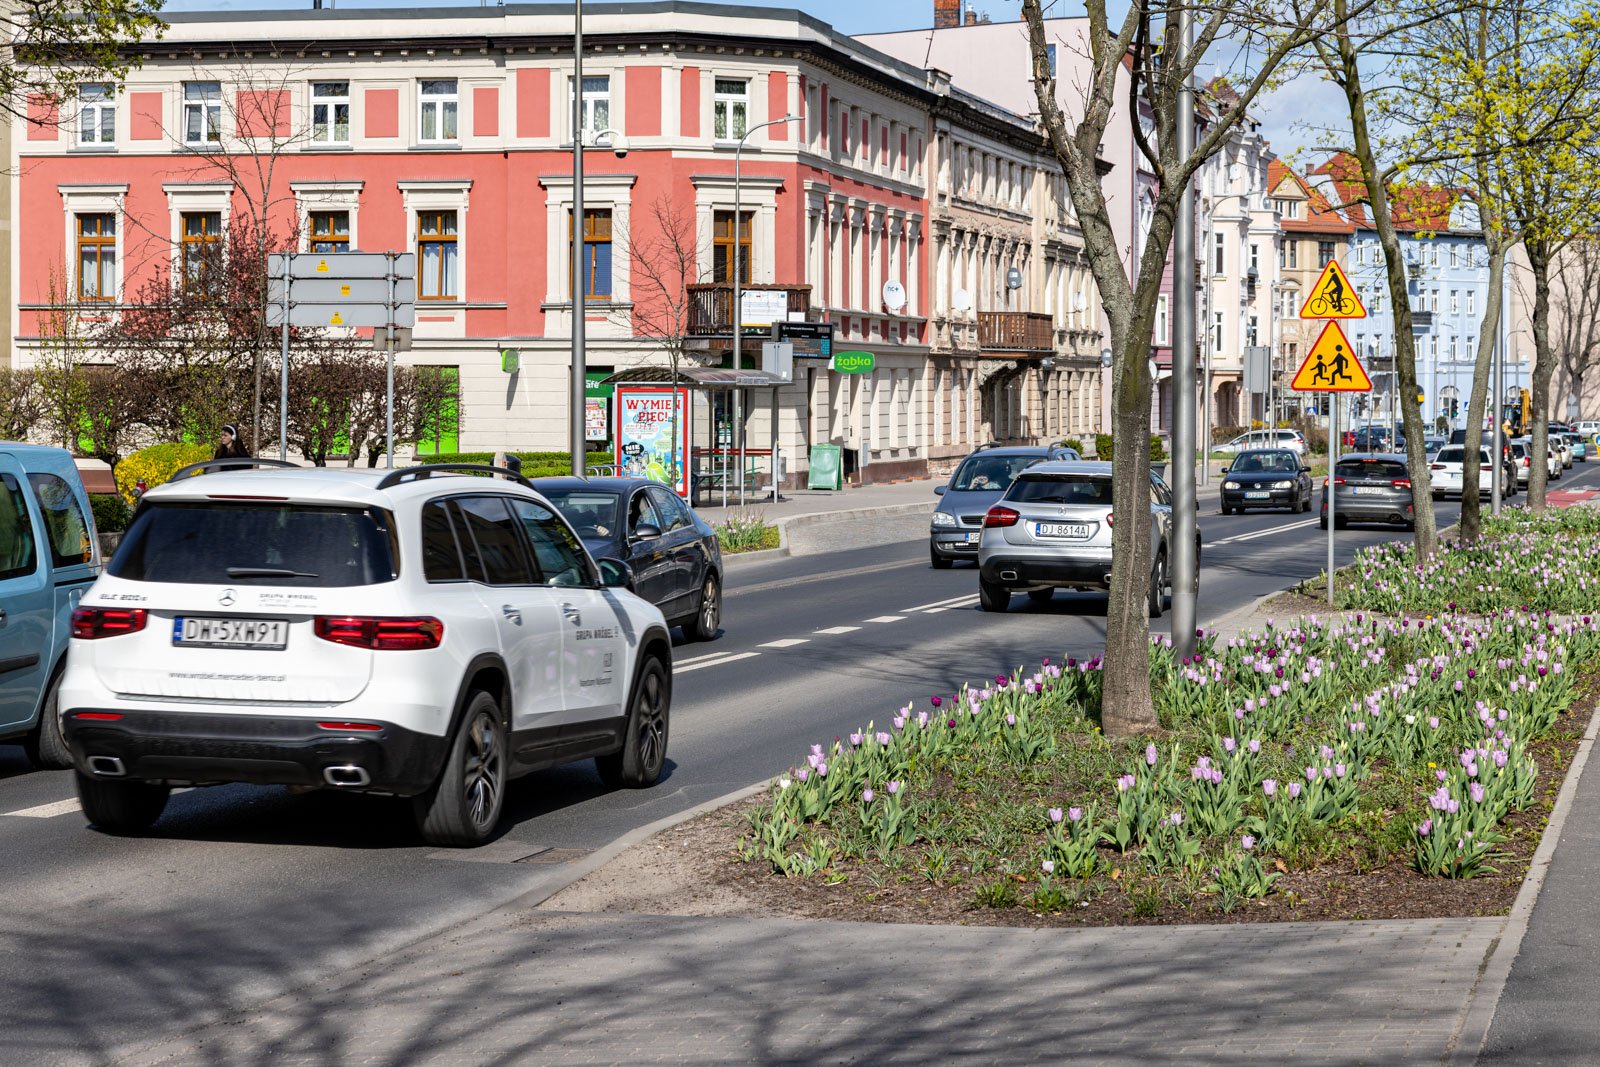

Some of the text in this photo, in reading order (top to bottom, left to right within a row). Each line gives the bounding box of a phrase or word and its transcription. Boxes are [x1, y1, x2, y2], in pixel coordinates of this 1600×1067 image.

[837, 356, 871, 366] żabka
[638, 411, 668, 422] PIEC!
[1042, 524, 1086, 535] DJ 8614A
